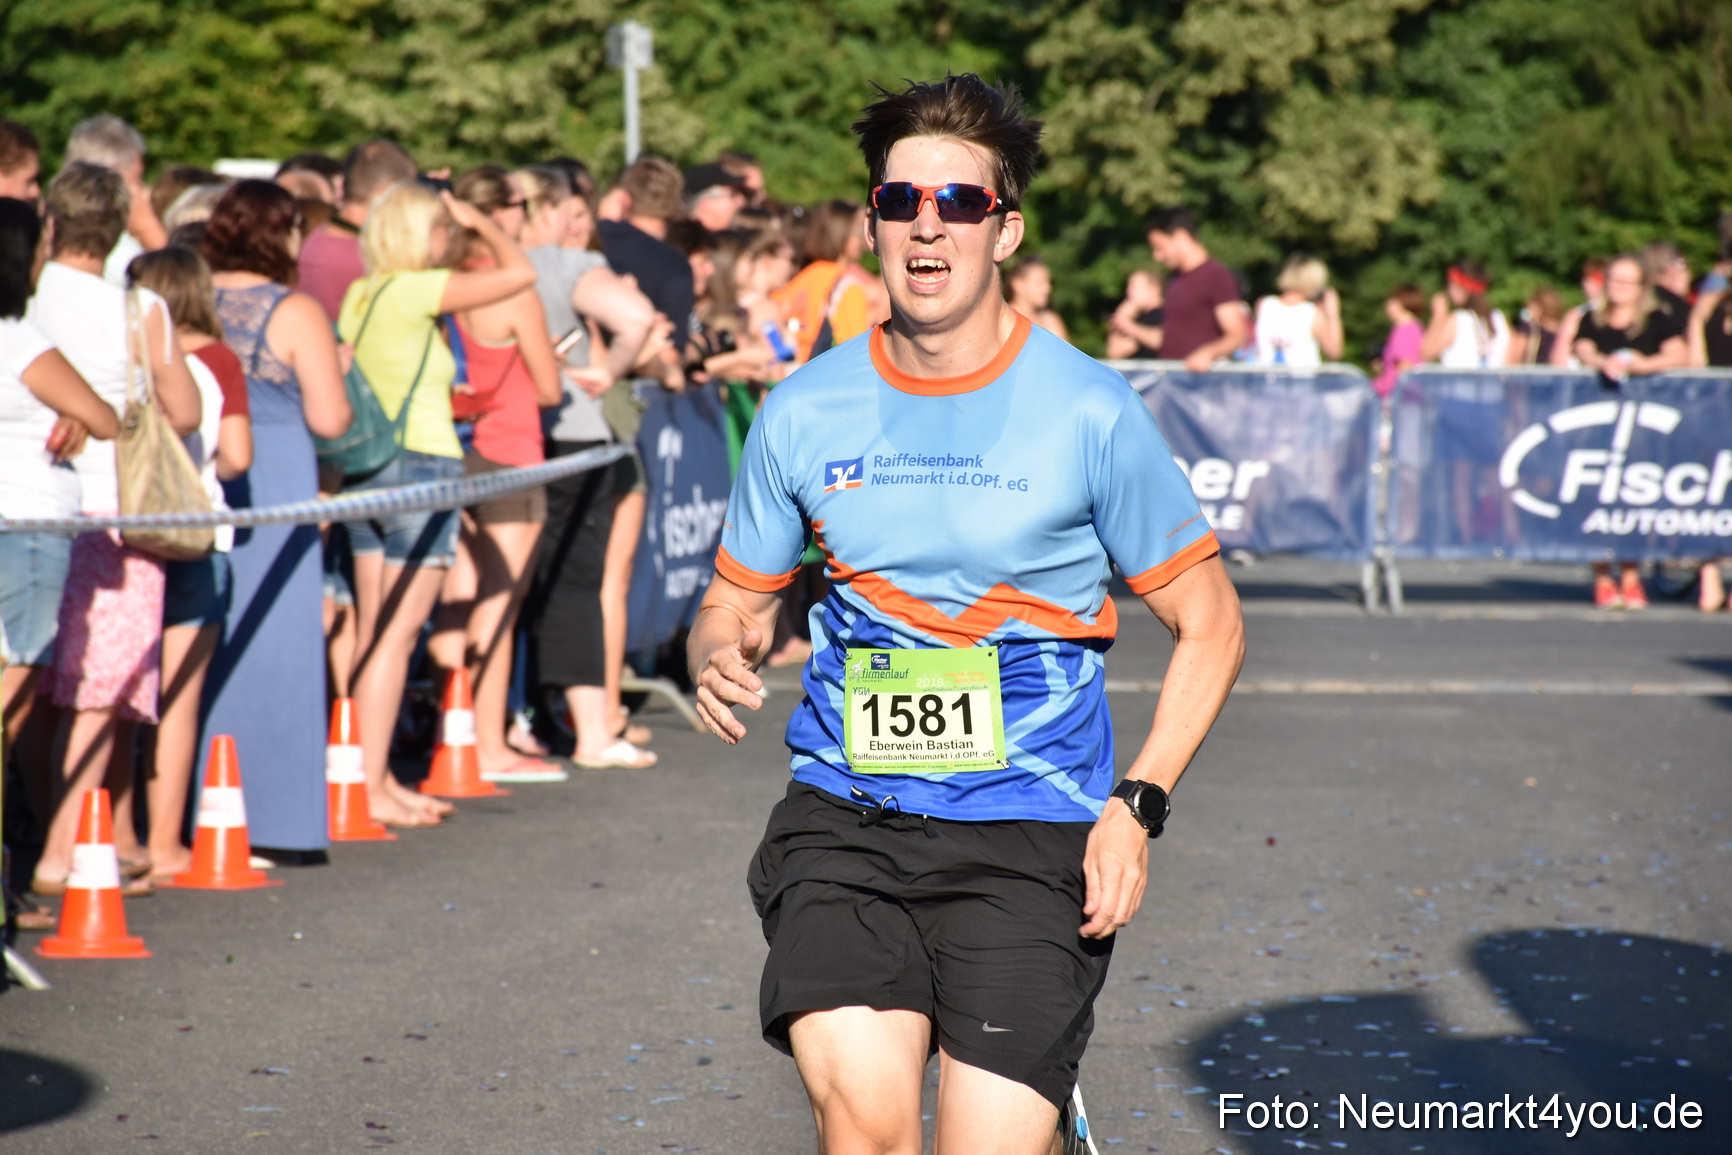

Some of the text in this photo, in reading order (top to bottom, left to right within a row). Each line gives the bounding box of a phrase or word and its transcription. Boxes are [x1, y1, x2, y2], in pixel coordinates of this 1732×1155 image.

[873, 454, 983, 469] Raiffeisenbank
[870, 471, 1029, 492] Neumarkt i.d.OPf. eG
[1173, 456, 1271, 500] er
[862, 668, 909, 679] firmenlauf
[915, 678, 945, 688] 2018
[862, 693, 973, 737] 1581
[869, 740, 974, 751] Eberwein Bastian
[852, 753, 907, 761] Raiffeisenbank
[909, 752, 949, 760] Neumarkt
[983, 750, 995, 758] eG
